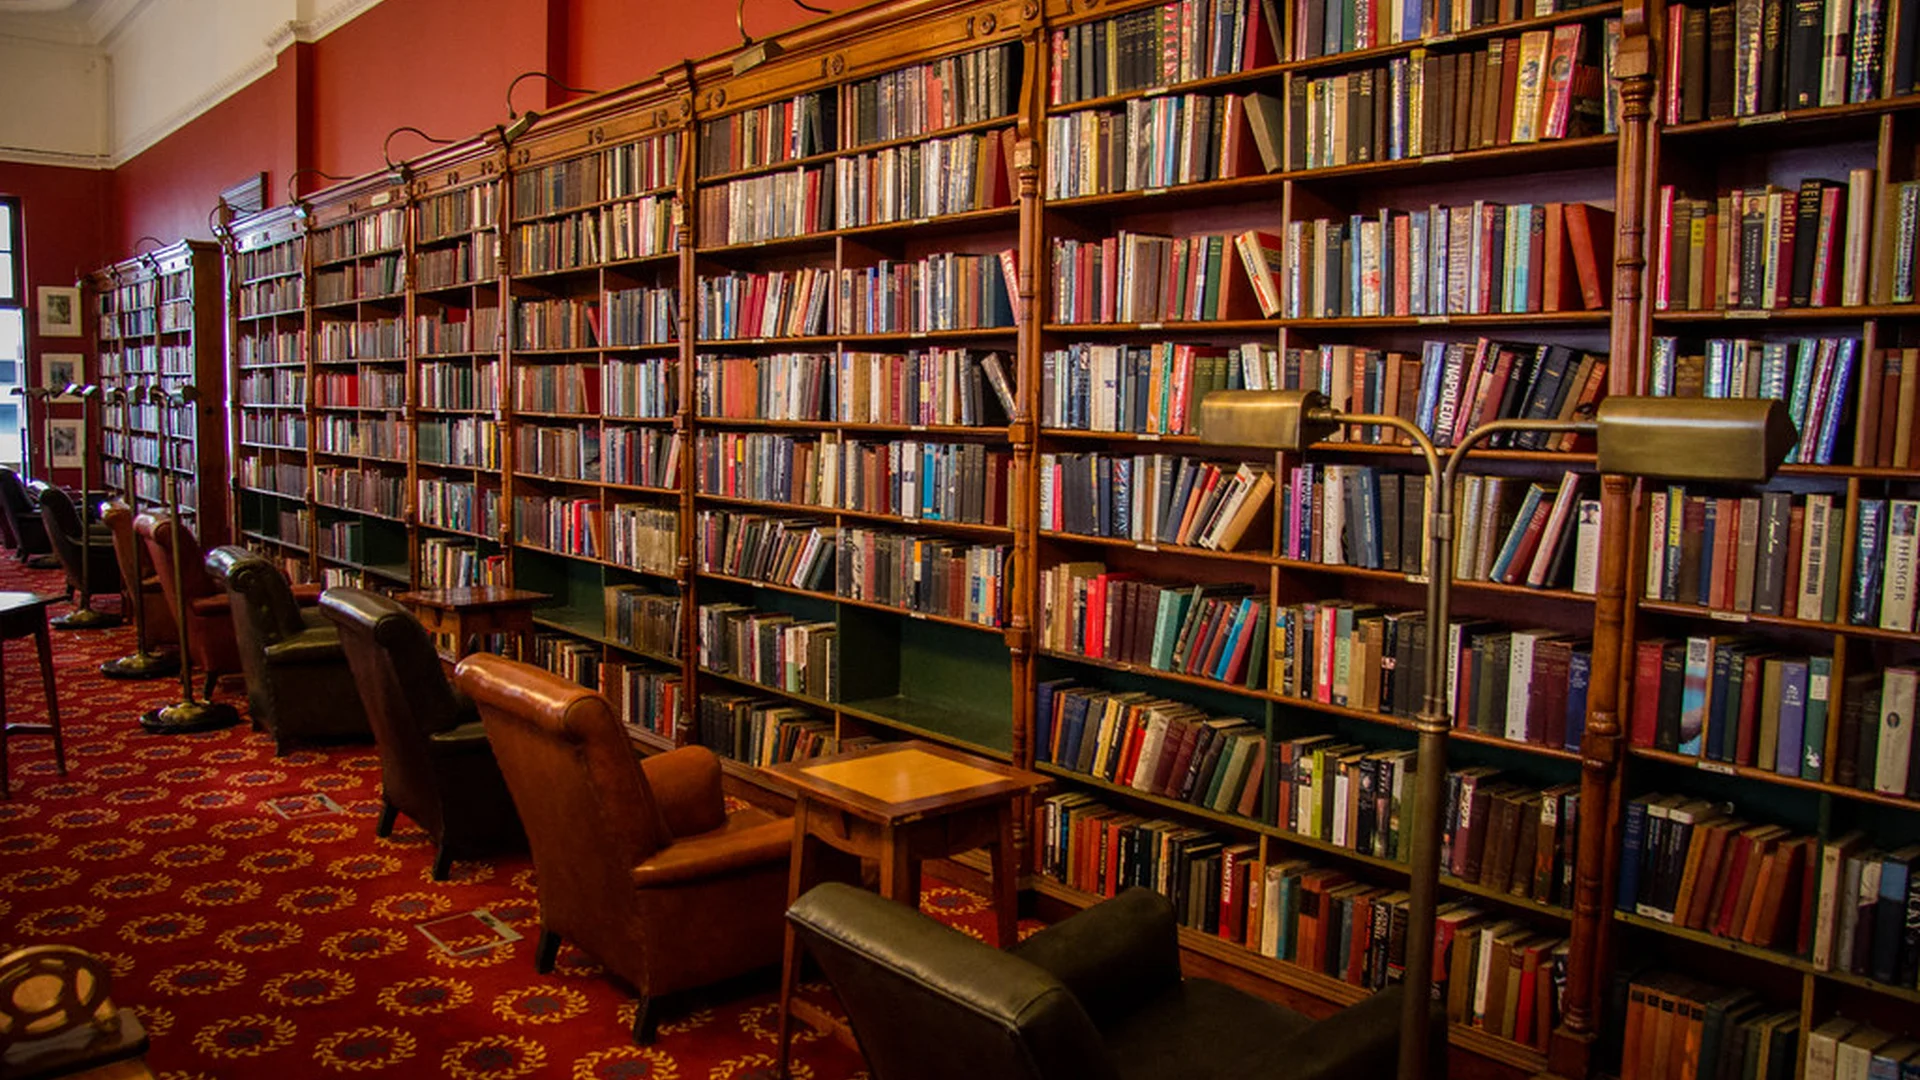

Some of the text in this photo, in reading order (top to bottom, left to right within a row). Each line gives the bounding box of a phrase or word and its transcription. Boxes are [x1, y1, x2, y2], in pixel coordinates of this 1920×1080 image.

[1437, 362, 1462, 429] NAPOLEON
[1891, 536, 1912, 602] THESIGER
[1221, 853, 1234, 903] MANSTEIN
